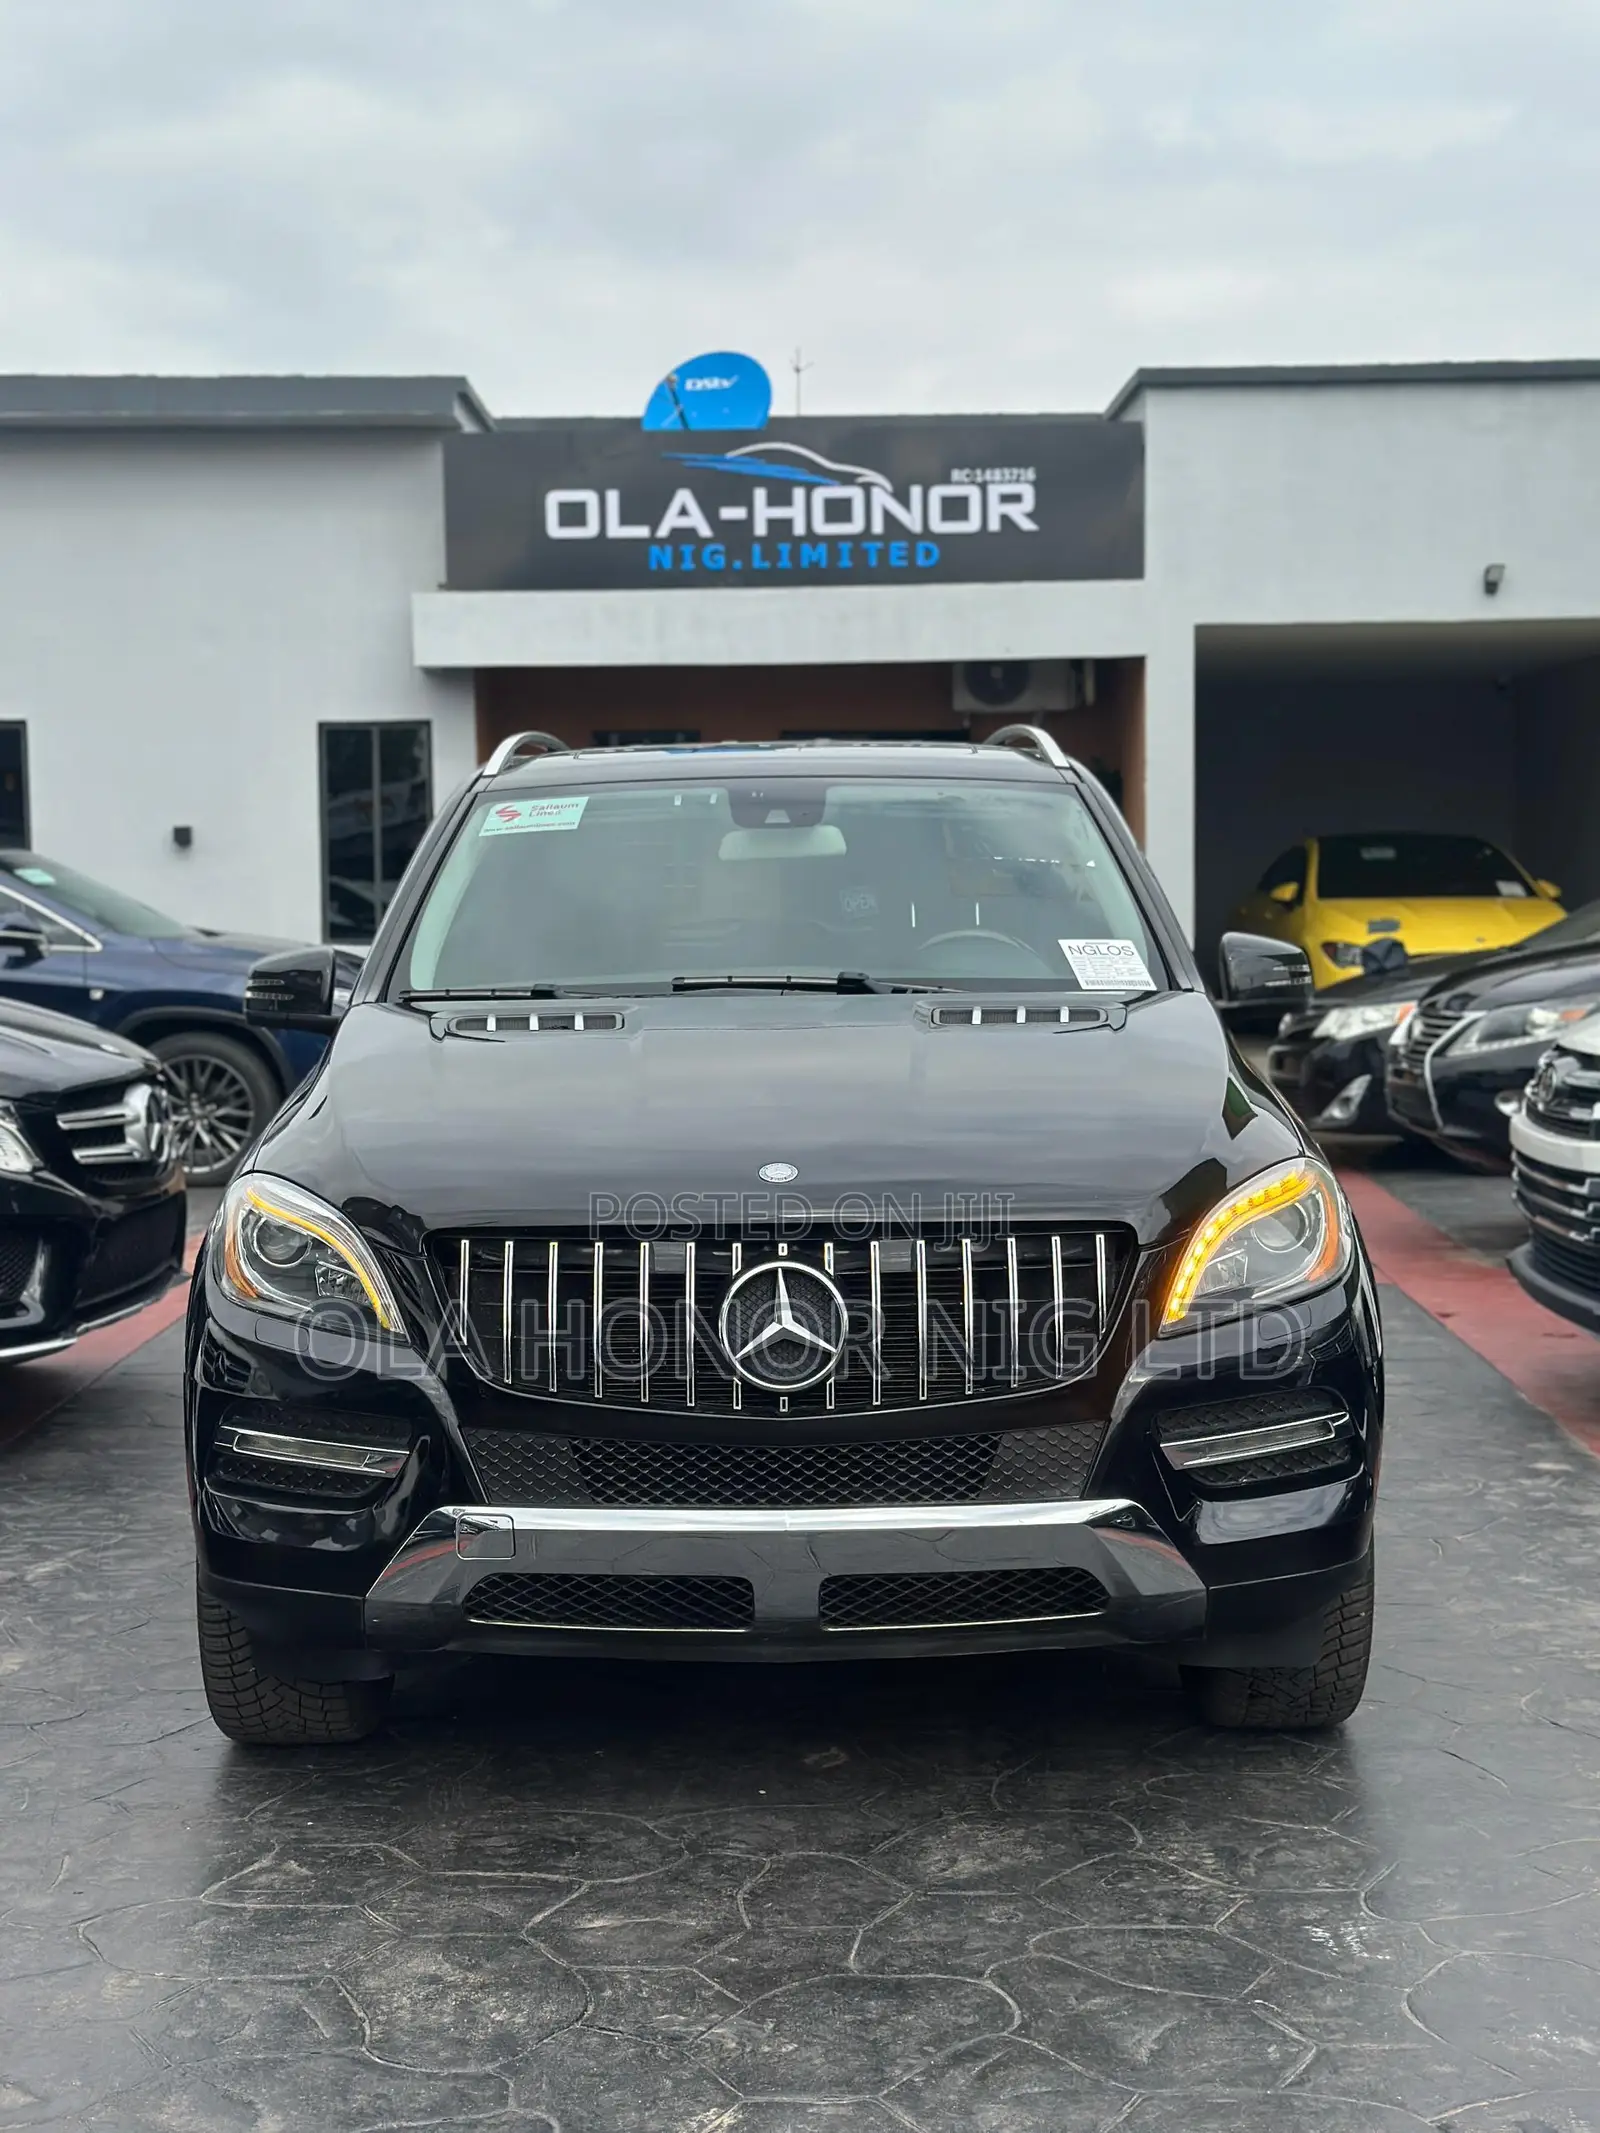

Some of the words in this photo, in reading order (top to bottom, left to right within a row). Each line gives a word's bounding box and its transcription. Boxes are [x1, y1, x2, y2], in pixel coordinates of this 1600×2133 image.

[545, 484, 1040, 539] OLA-HONOR
[648, 541, 940, 571] NIG.LIMITED
[531, 803, 579, 813] Sallaum
[1068, 945, 1135, 956] NGLOS
